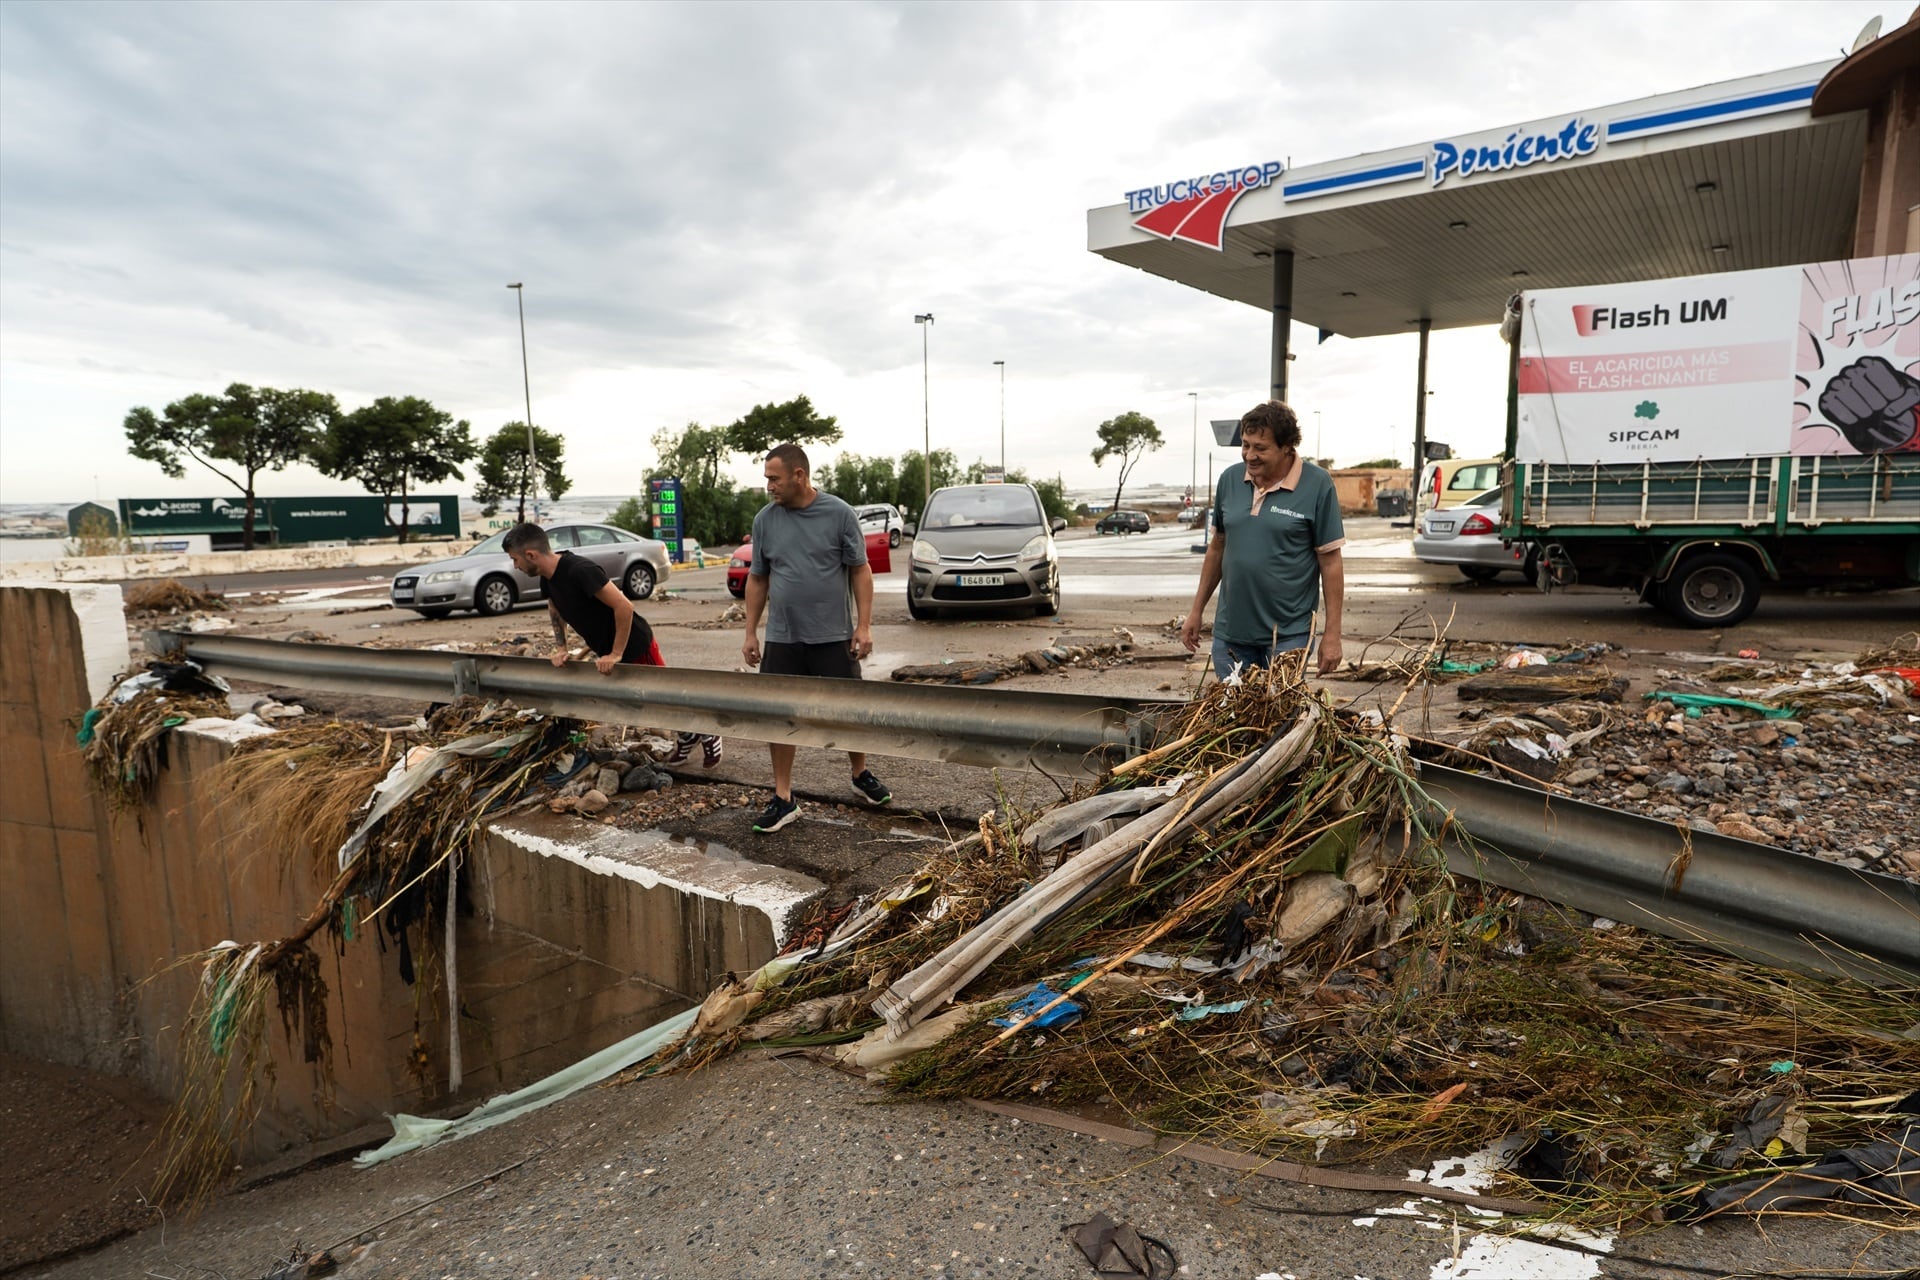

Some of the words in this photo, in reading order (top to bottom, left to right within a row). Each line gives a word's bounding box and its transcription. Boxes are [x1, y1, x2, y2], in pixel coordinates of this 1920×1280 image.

[1433, 118, 1595, 182] Poniente
[1124, 178, 1204, 211] TRUCK
[1209, 161, 1282, 193] STOP
[1591, 304, 1670, 331] Flash
[1679, 298, 1728, 323] UM
[1568, 361, 1589, 375] EL
[1594, 355, 1686, 373] ACARICIDA
[1691, 350, 1730, 367] MÁS
[1577, 368, 1719, 390] FLASH-CINANTE
[1608, 428, 1680, 443] SIPCAM
[963, 576, 984, 585] 1648
